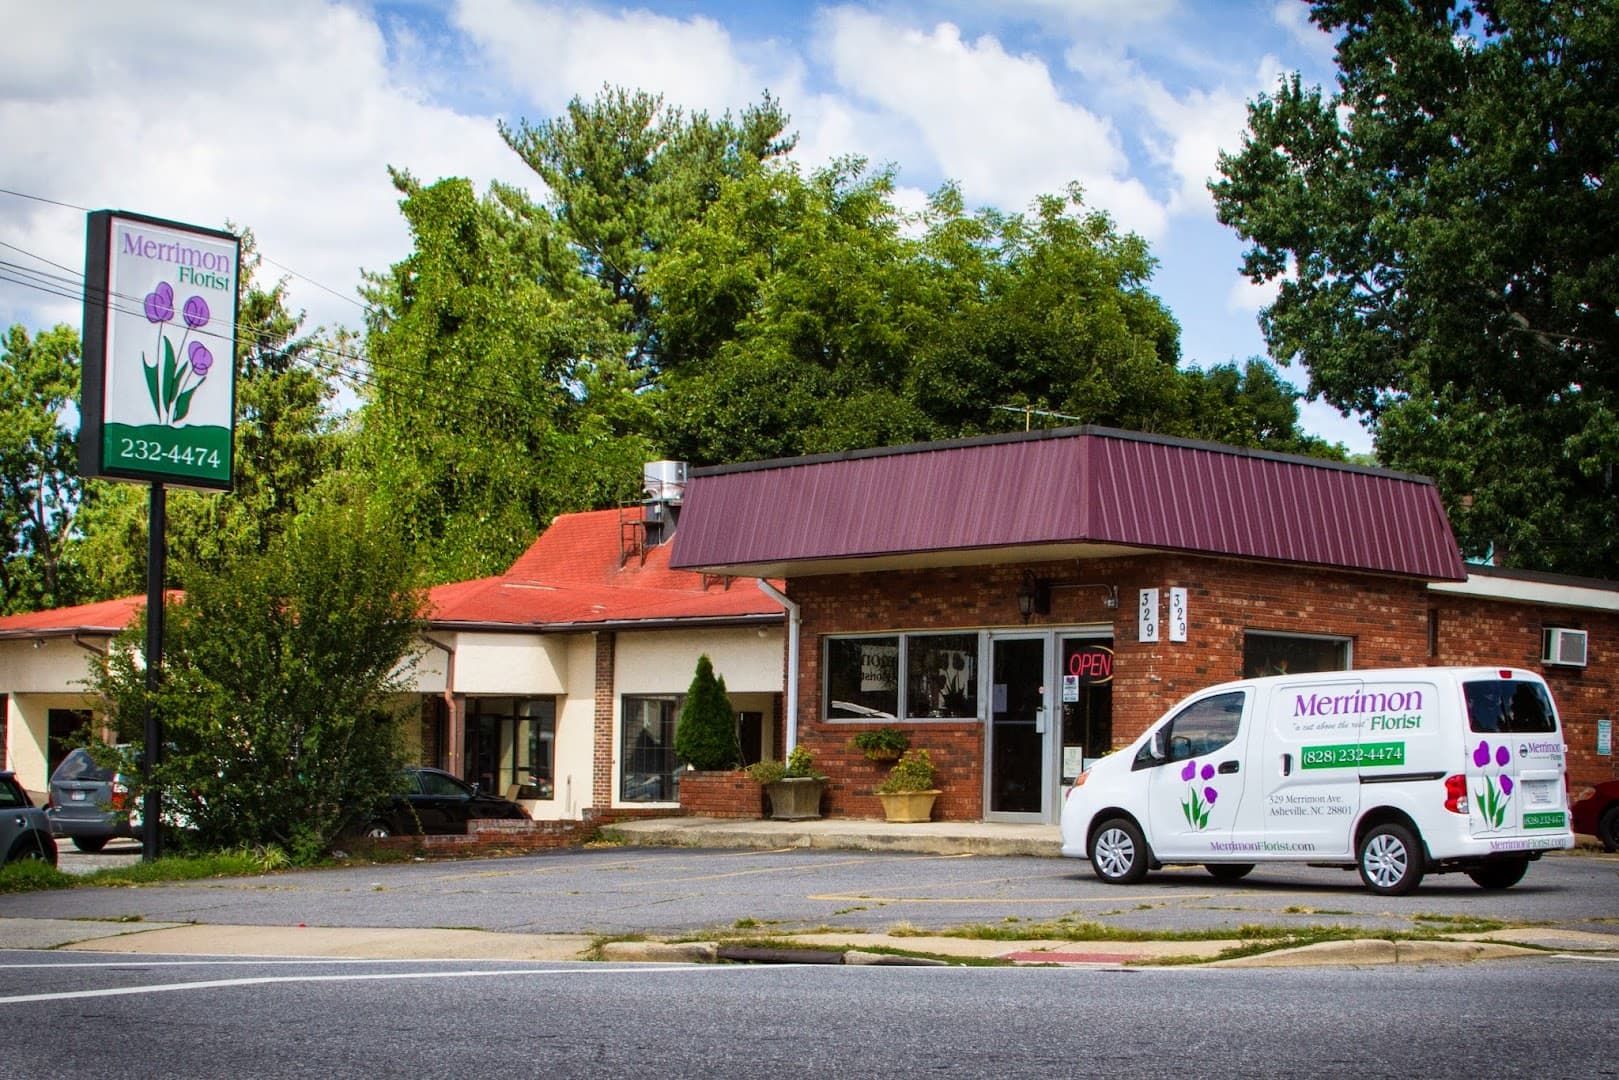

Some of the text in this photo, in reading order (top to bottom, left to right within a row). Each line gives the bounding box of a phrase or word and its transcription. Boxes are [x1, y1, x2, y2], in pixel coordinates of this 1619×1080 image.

[122, 232, 230, 274] Merrimon
[178, 266, 230, 292] Florist
[120, 437, 221, 469] 232-4474
[1142, 593, 1154, 637] 329
[1173, 594, 1186, 636] 329
[1069, 653, 1112, 676] OPEN
[1293, 689, 1423, 717] Merrimon
[1370, 714, 1422, 731] Florist
[1303, 747, 1403, 765] (828) 232-4474
[1286, 794, 1326, 804] Merrimon
[1312, 806, 1324, 816] NC
[1327, 805, 1352, 816] 28801
[1210, 840, 1315, 852] MerrimonFlorist.com
